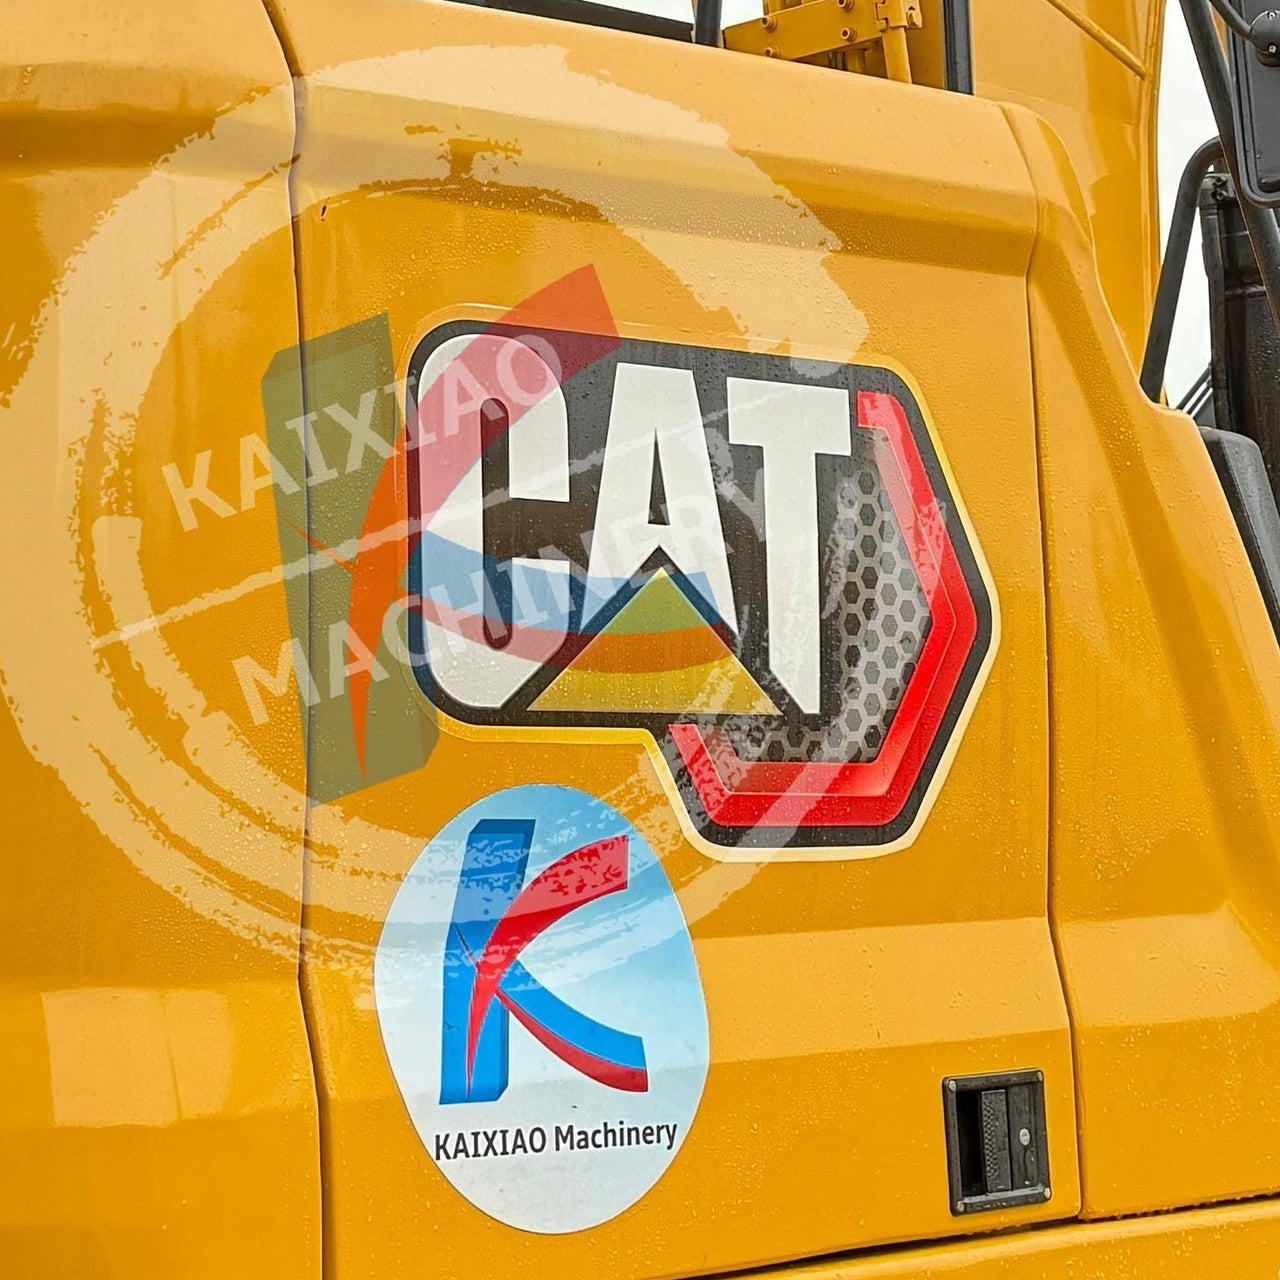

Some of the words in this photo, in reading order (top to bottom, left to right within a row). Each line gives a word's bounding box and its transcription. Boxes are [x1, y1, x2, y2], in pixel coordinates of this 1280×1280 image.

[418, 333, 851, 715] CAT
[435, 1126, 547, 1161] KAIXIAO
[555, 1121, 678, 1152] Machinery
